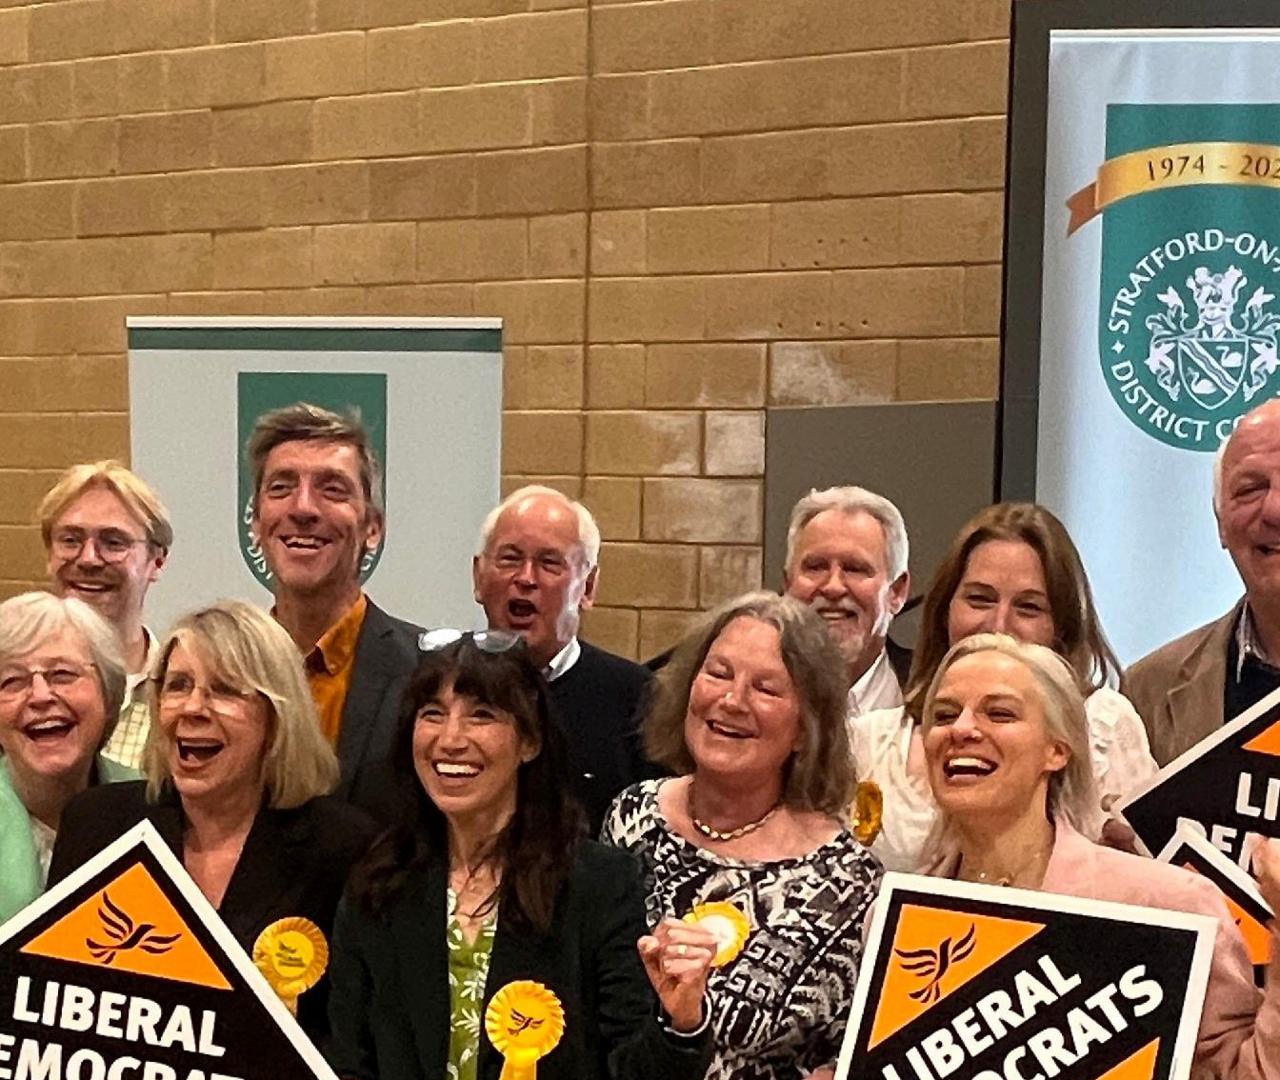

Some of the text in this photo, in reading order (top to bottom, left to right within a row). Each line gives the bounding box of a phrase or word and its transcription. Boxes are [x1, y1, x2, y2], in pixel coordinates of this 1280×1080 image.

[1148, 154, 1205, 181] 1974
[1111, 360, 1210, 442] DISTRICT
[12, 976, 227, 1058] LIBERAL
